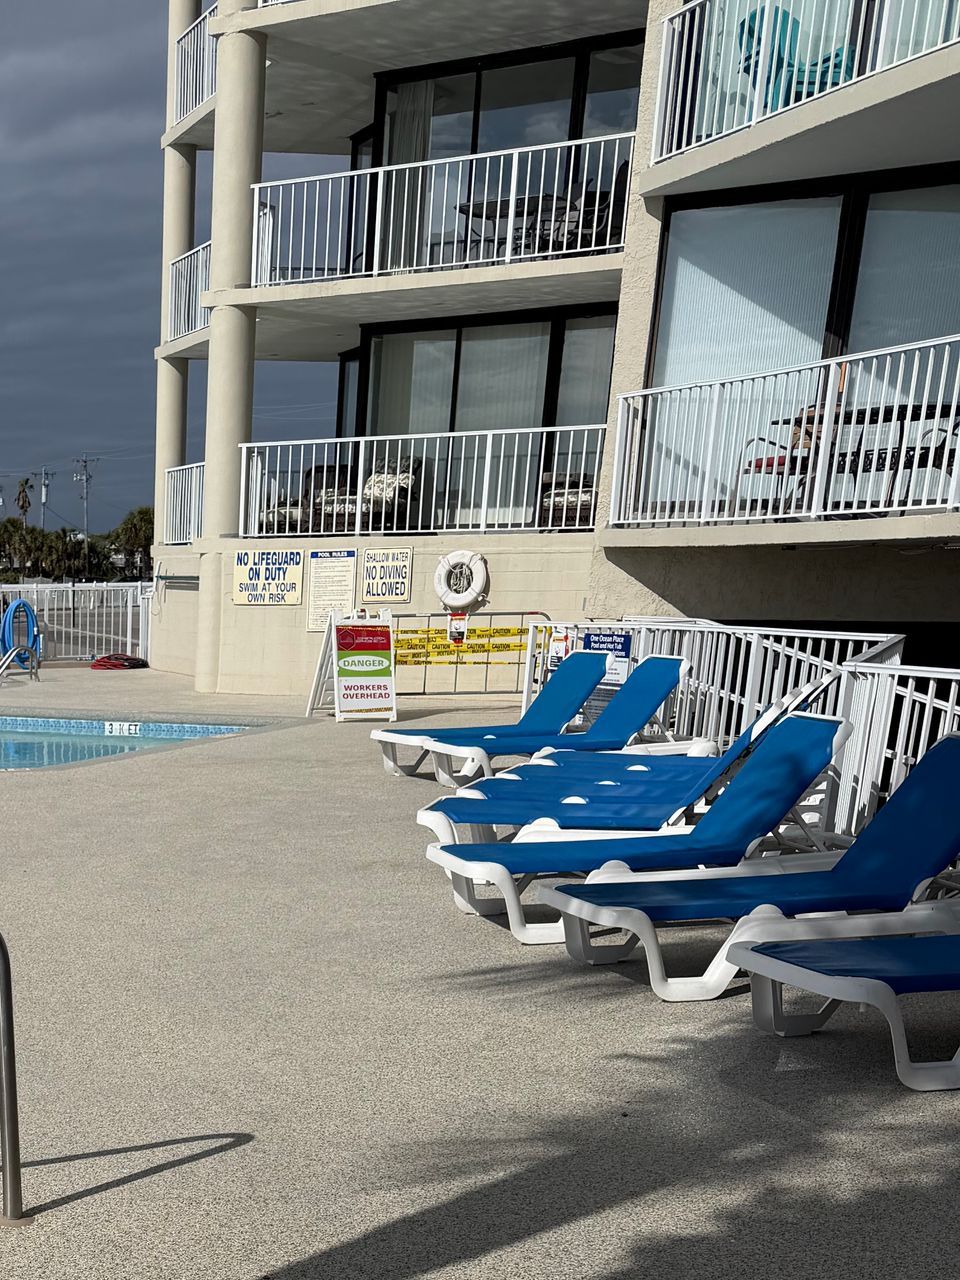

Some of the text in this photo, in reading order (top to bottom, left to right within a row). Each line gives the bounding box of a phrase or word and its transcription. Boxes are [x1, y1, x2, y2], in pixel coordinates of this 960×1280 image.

[236, 551, 301, 566] NO LIFEGUARD
[366, 551, 409, 563] SHALLOW WATER
[248, 566, 288, 581] ON DUTY
[365, 564, 407, 580] NO DIVING
[238, 582, 297, 593] SWIM AT YOUR
[365, 581, 406, 597] ALLOWED
[247, 593, 287, 603] OWN RISK
[613, 635, 624, 643] Place
[343, 659, 384, 667] DANGER
[343, 684, 389, 692] WORKERS
[342, 692, 391, 700] OVERHEAD
